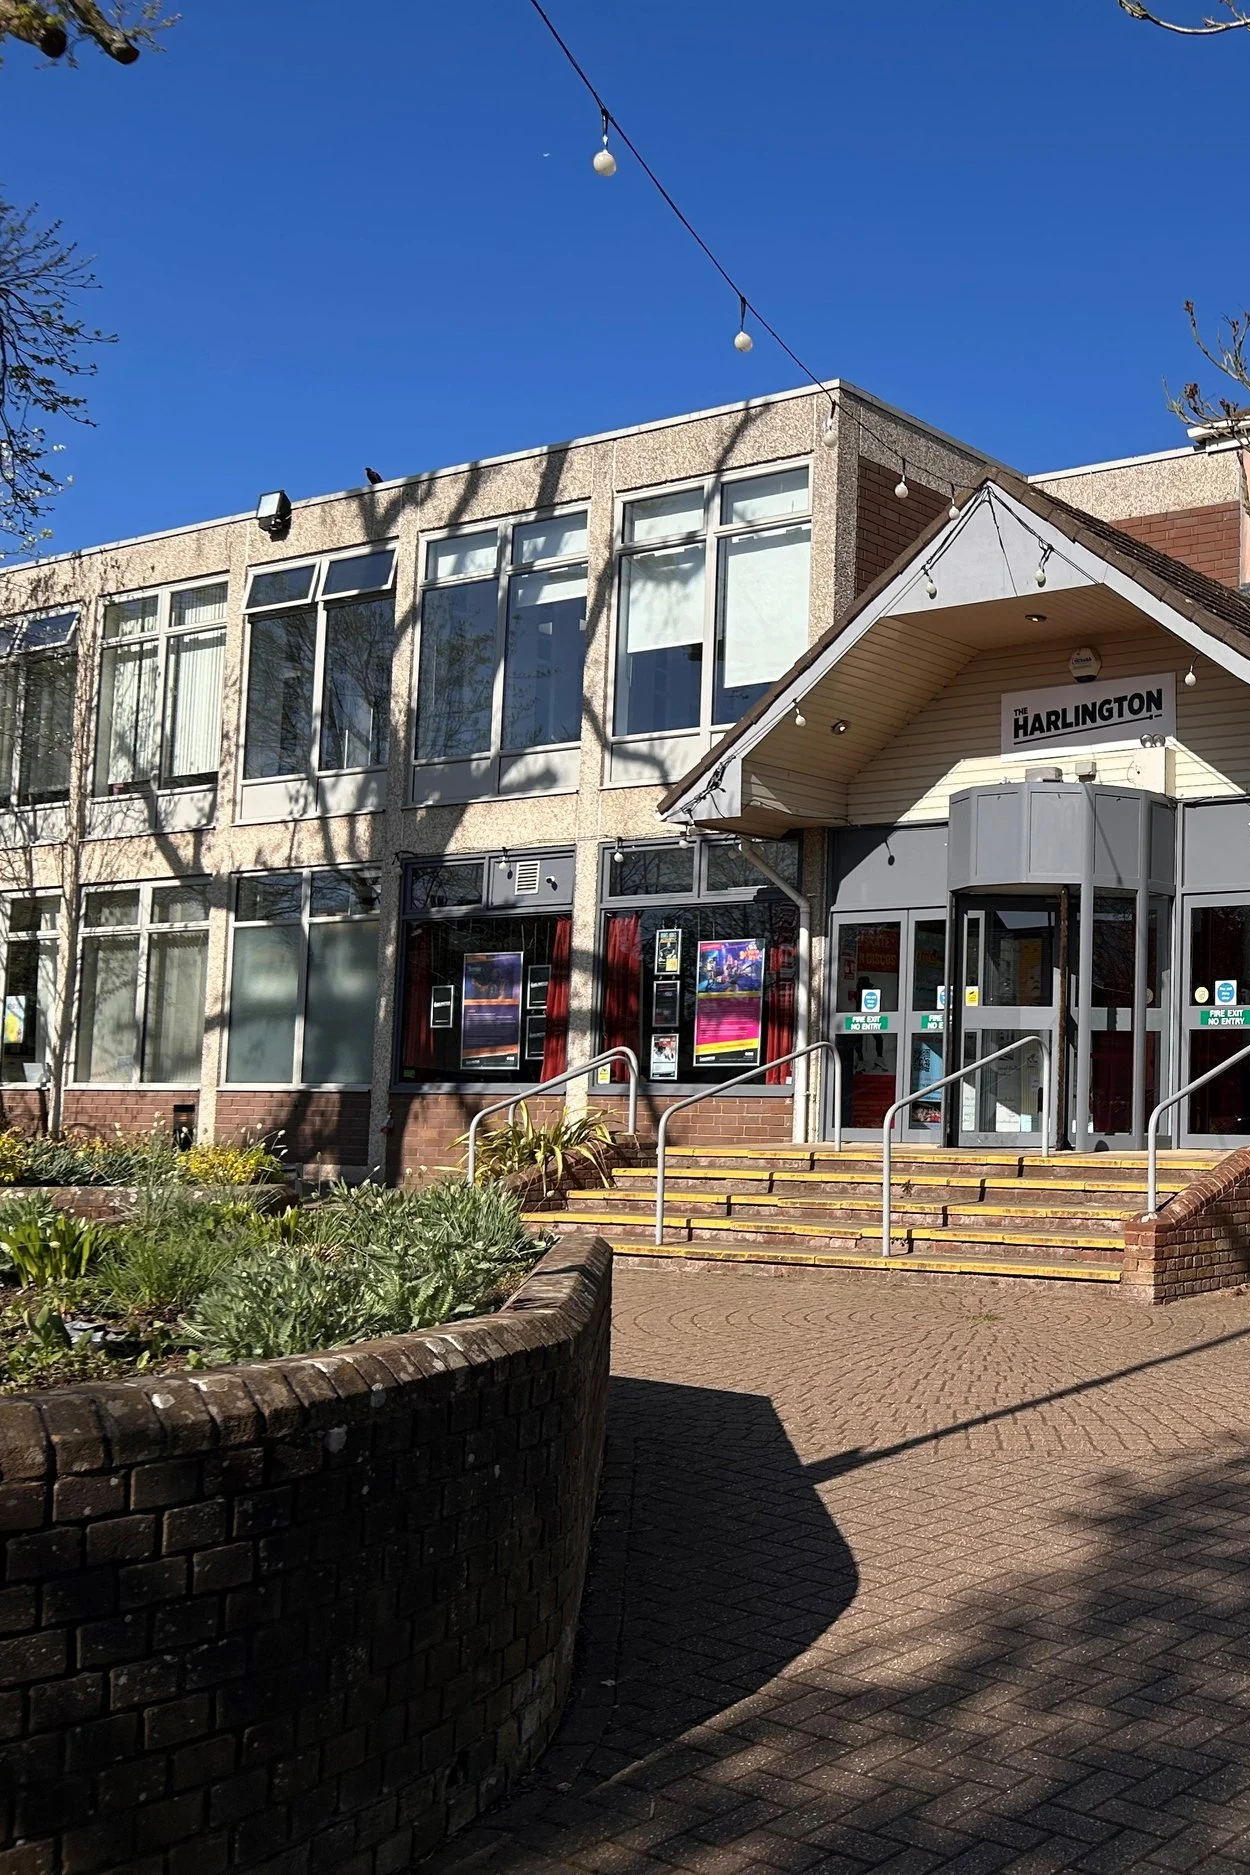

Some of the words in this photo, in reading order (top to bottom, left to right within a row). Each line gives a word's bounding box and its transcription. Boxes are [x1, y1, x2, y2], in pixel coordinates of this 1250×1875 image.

[1014, 707, 1028, 717] THE
[1014, 688, 1162, 738] HARLINGTON
[1209, 1009, 1225, 1017] FIRE
[1227, 1009, 1243, 1017] EXIT
[852, 1015, 866, 1023] FIRE
[866, 1015, 881, 1023] EXIT
[1208, 1017, 1219, 1025] NO
[1221, 1017, 1245, 1025] ENTRY
[851, 1022, 861, 1030] NO
[861, 1022, 882, 1030] ENTRY
[927, 1021, 938, 1029] NO
